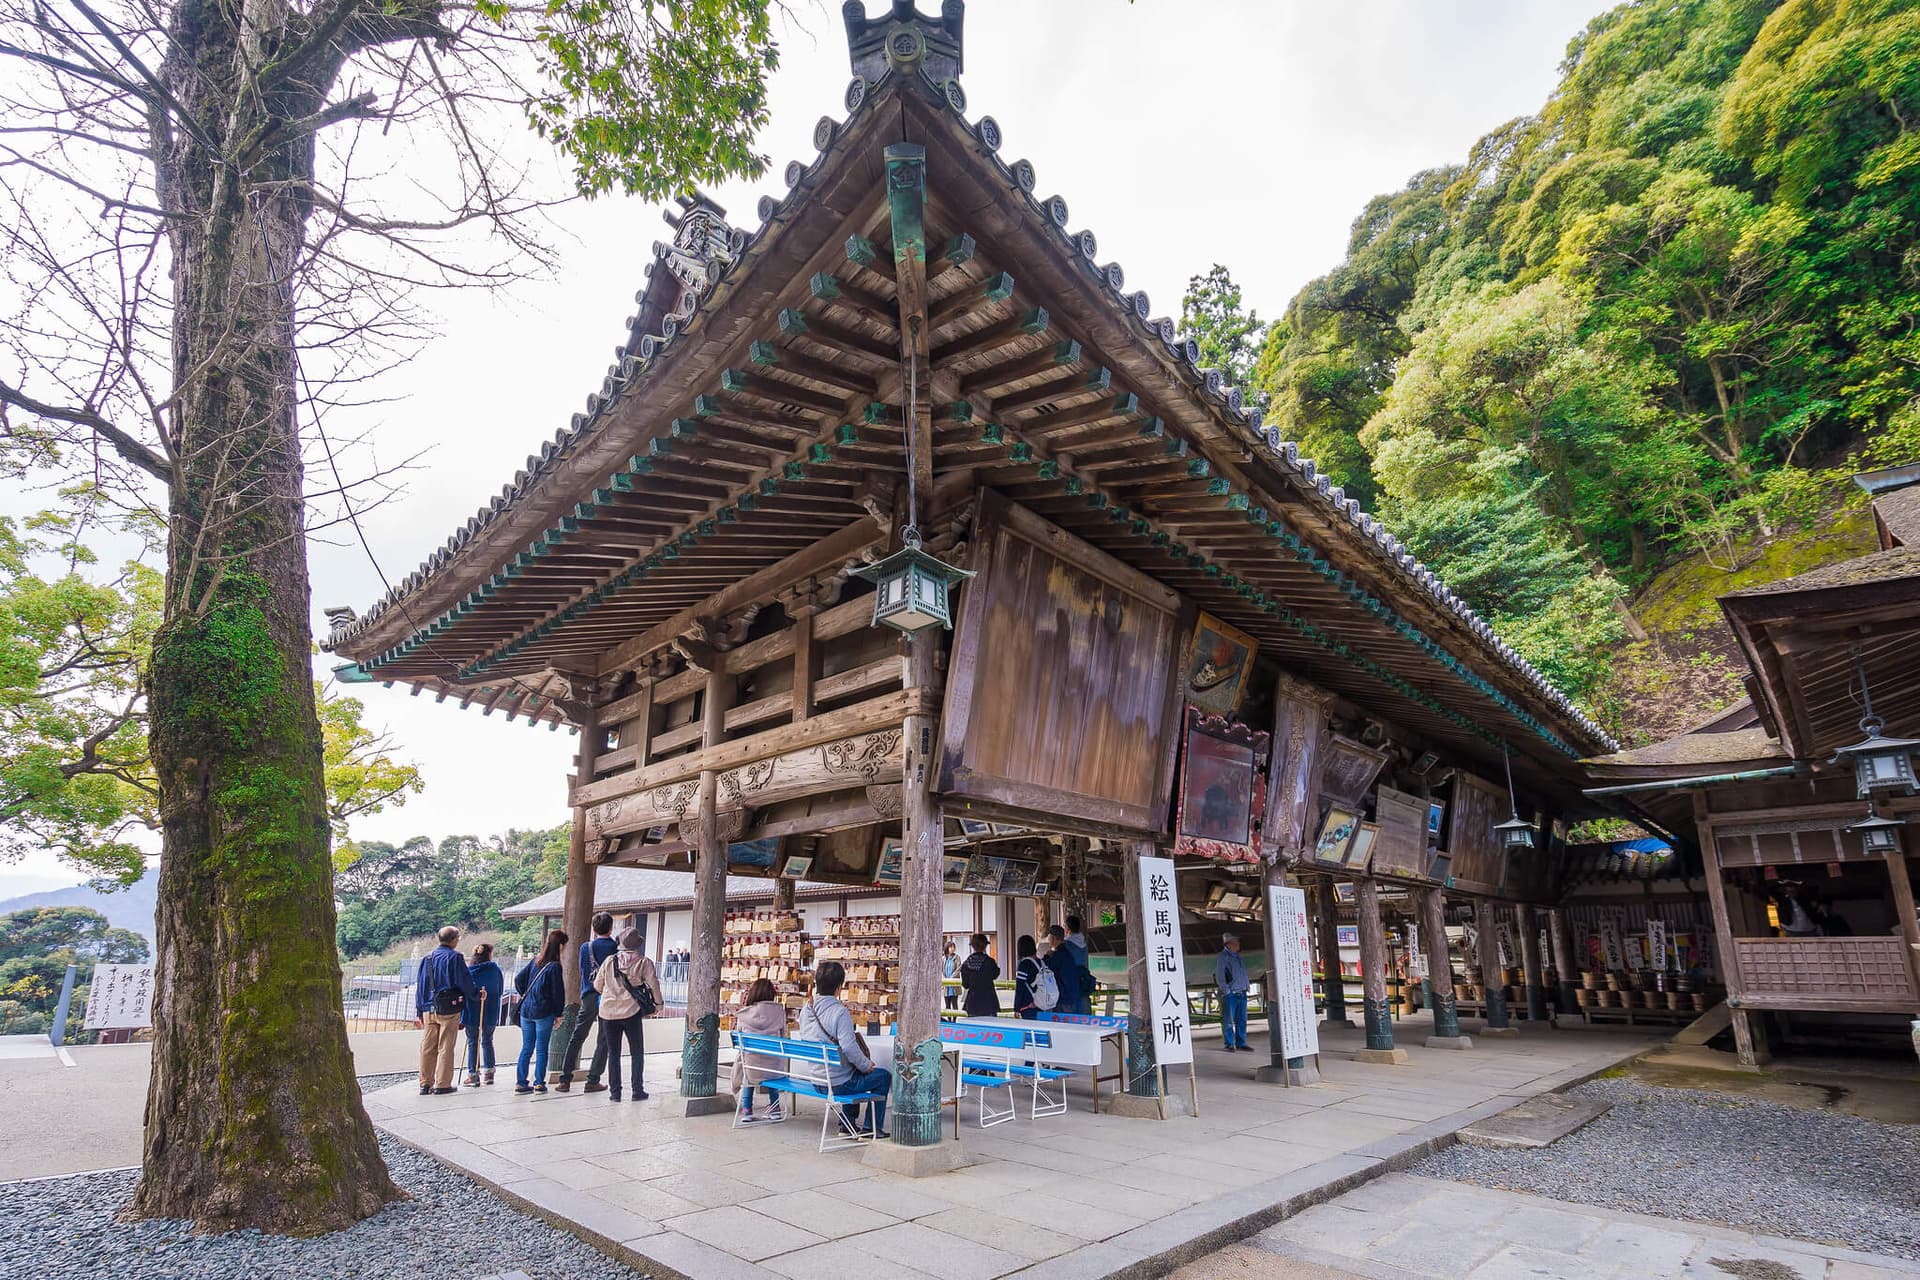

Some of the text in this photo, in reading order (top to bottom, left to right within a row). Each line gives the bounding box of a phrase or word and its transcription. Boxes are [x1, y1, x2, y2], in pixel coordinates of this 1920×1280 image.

[1149, 874, 1183, 1046] 絵馬記入所
[1297, 912, 1312, 1000] 境内禁煙
